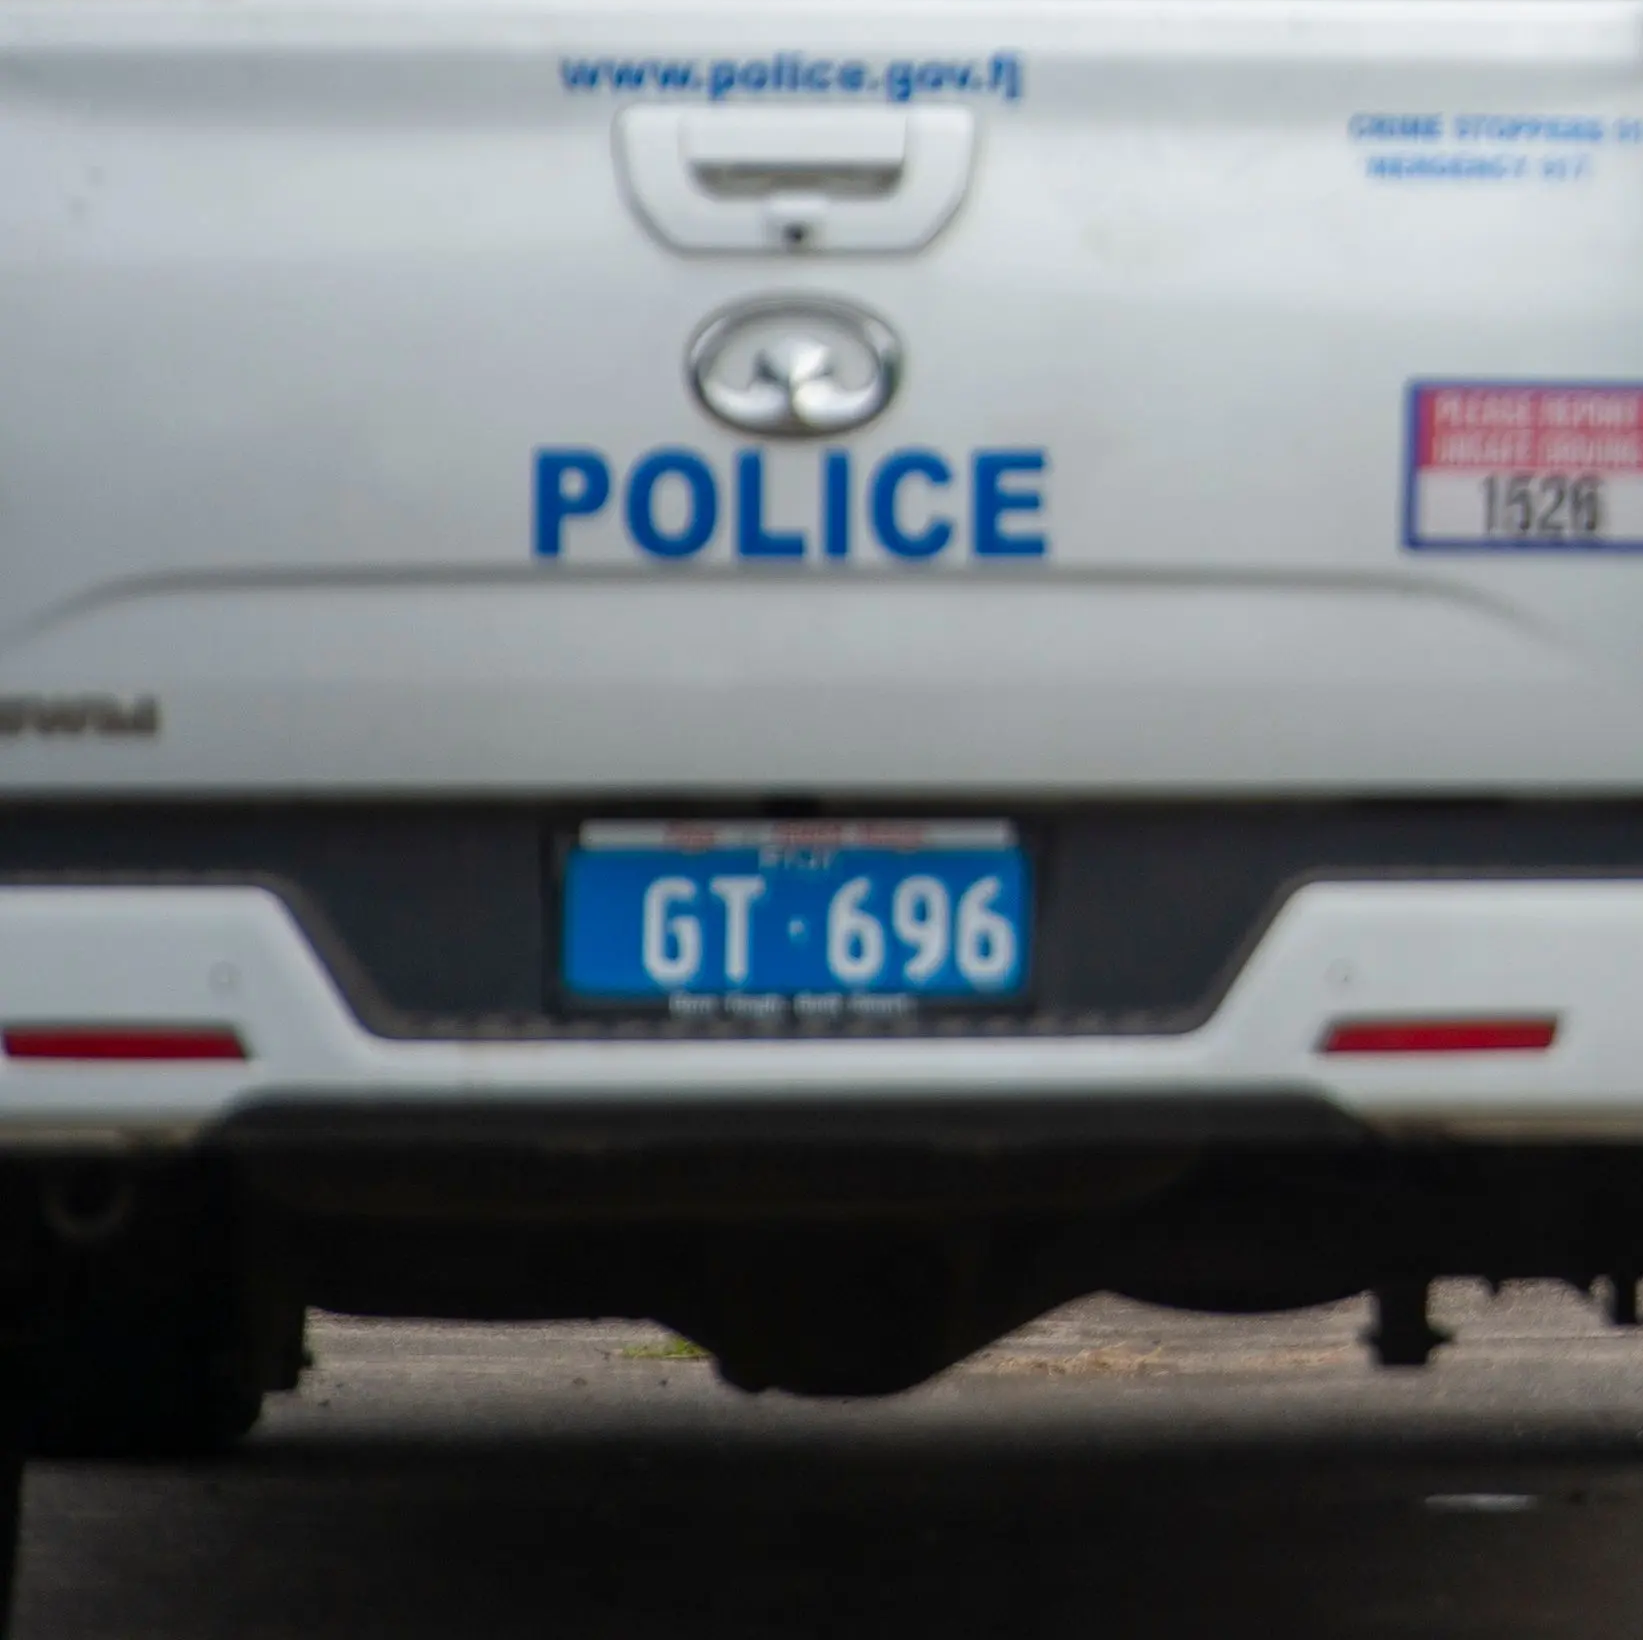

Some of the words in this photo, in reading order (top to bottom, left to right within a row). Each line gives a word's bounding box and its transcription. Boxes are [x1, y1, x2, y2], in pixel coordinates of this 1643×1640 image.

[562, 50, 1023, 102] www.police.gov.fj
[533, 445, 1047, 558] POLICE
[641, 874, 767, 986] GT
[825, 874, 1017, 989] 696
